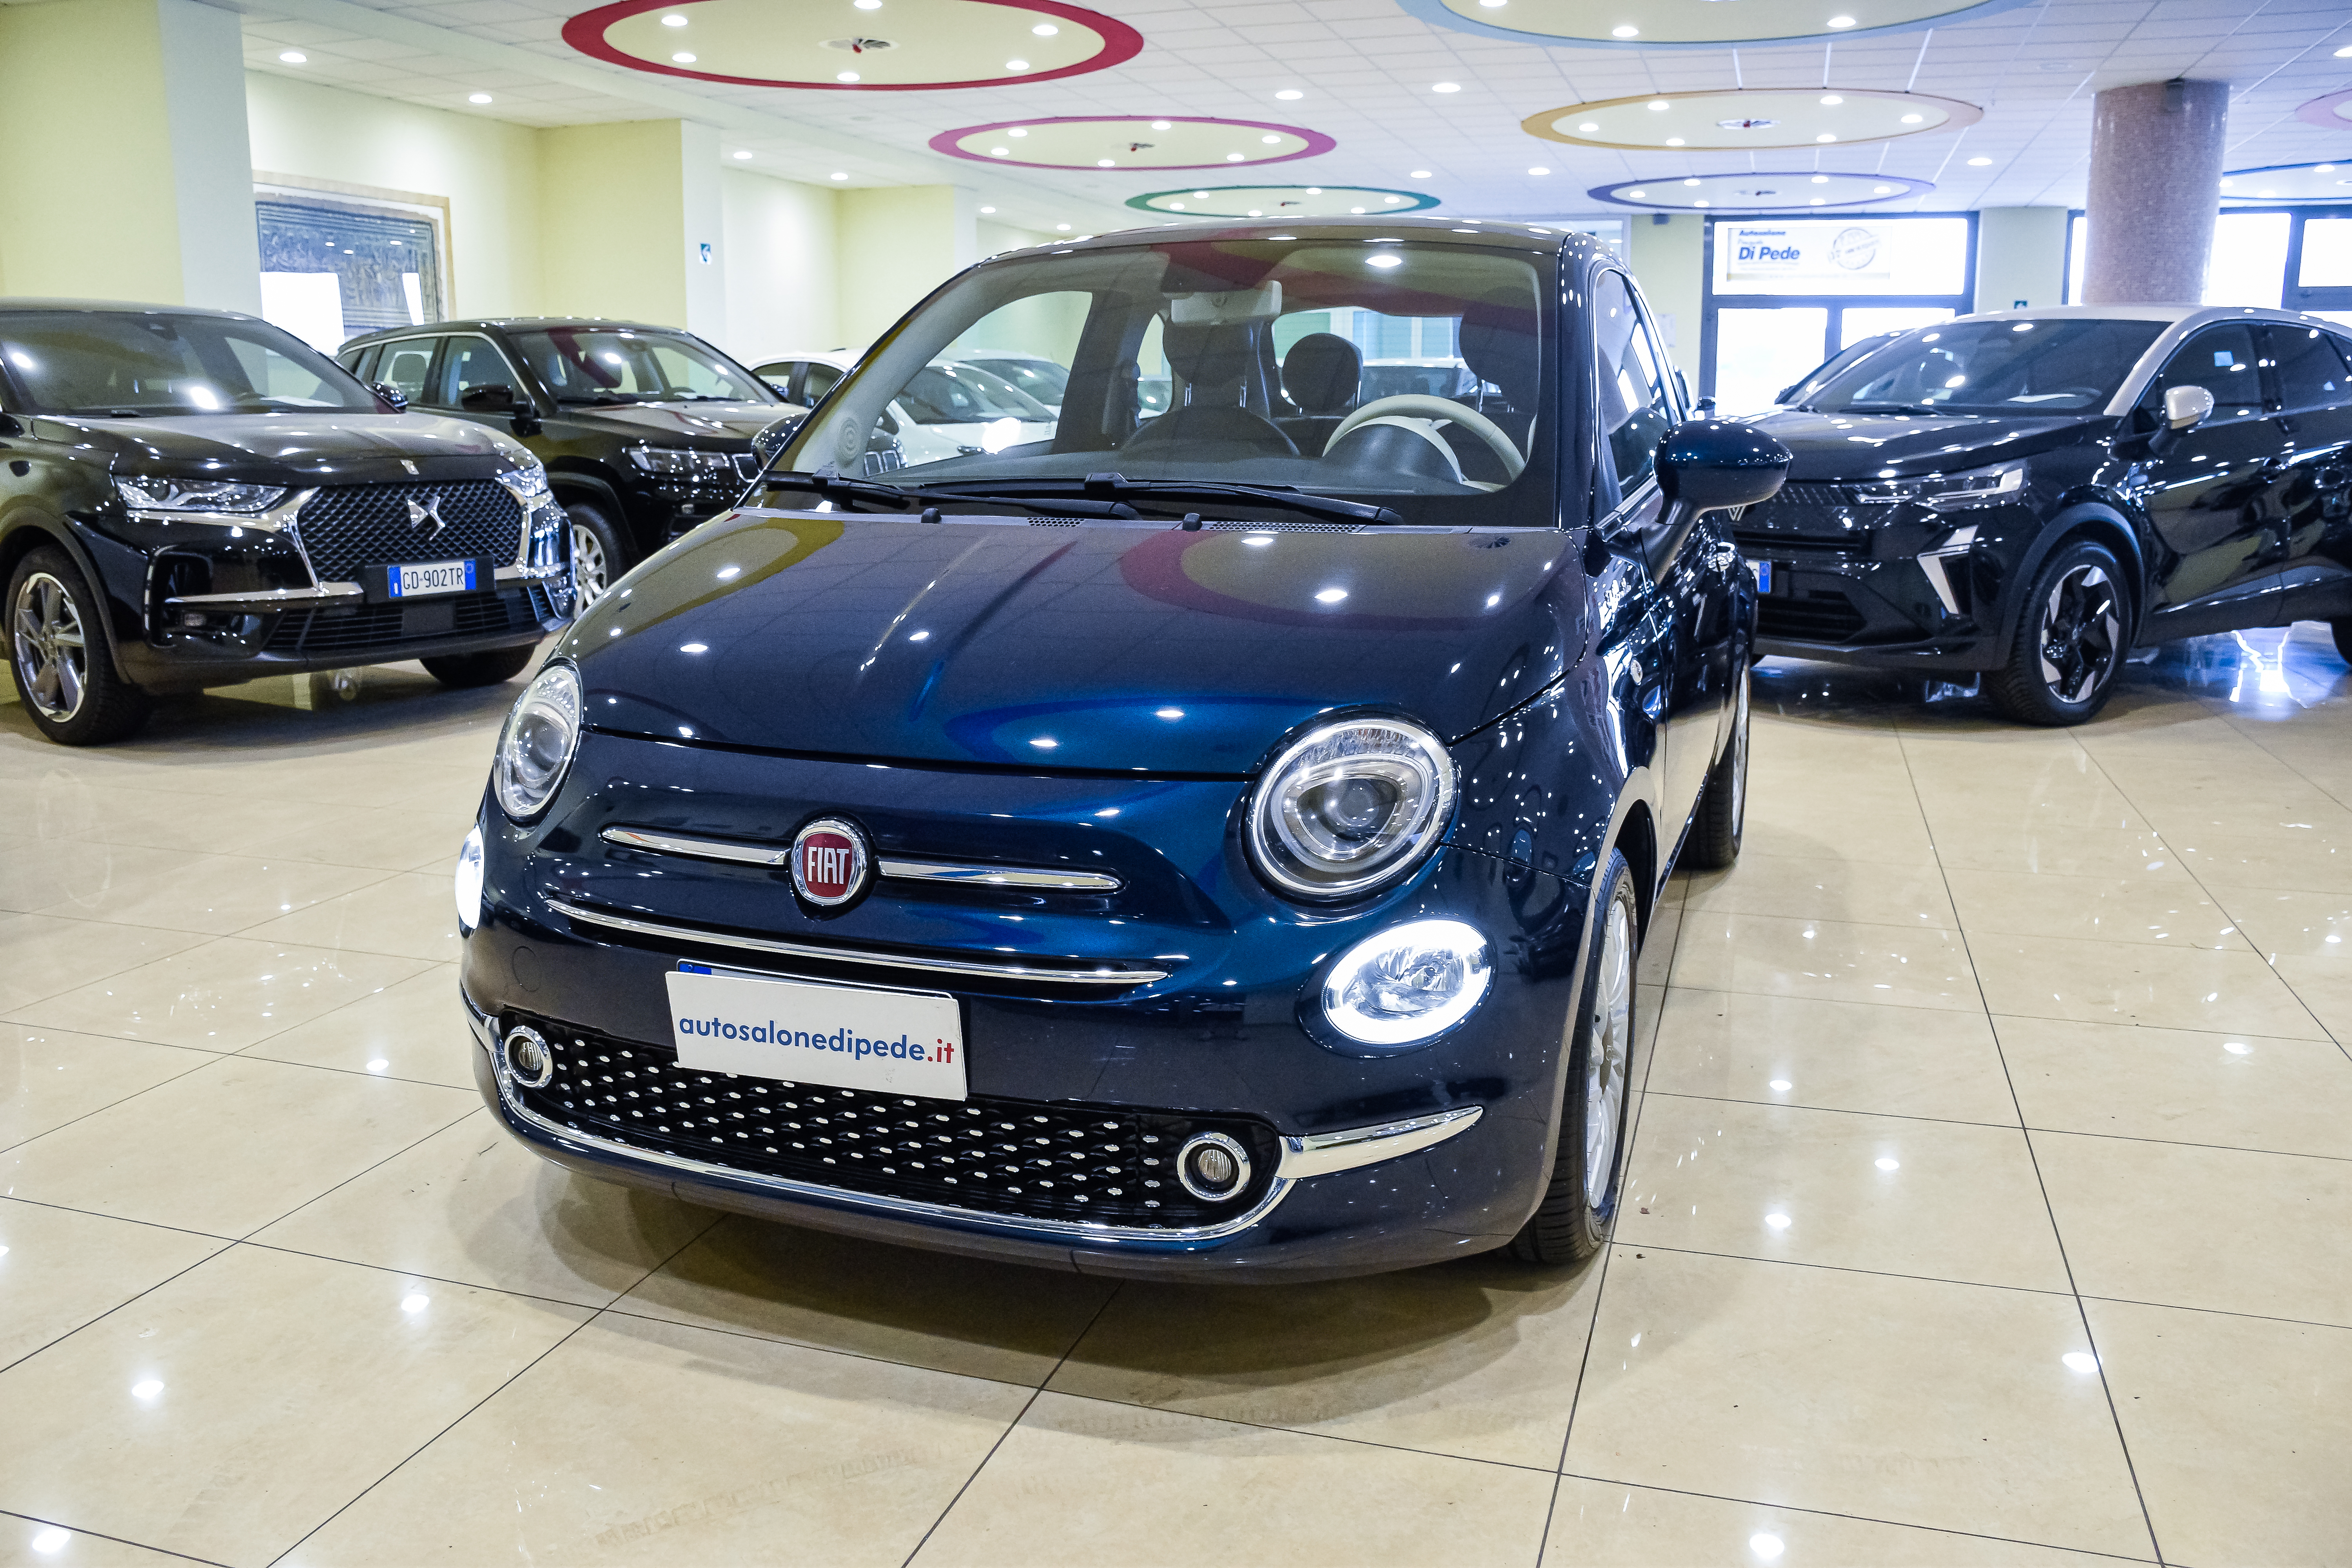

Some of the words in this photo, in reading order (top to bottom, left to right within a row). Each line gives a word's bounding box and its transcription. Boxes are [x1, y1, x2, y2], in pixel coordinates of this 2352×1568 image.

[1739, 247, 1755, 260] Di
[1759, 246, 1800, 260] Pede
[807, 846, 849, 885] FIAT
[679, 1017, 955, 1064] autosalonedipede.it
